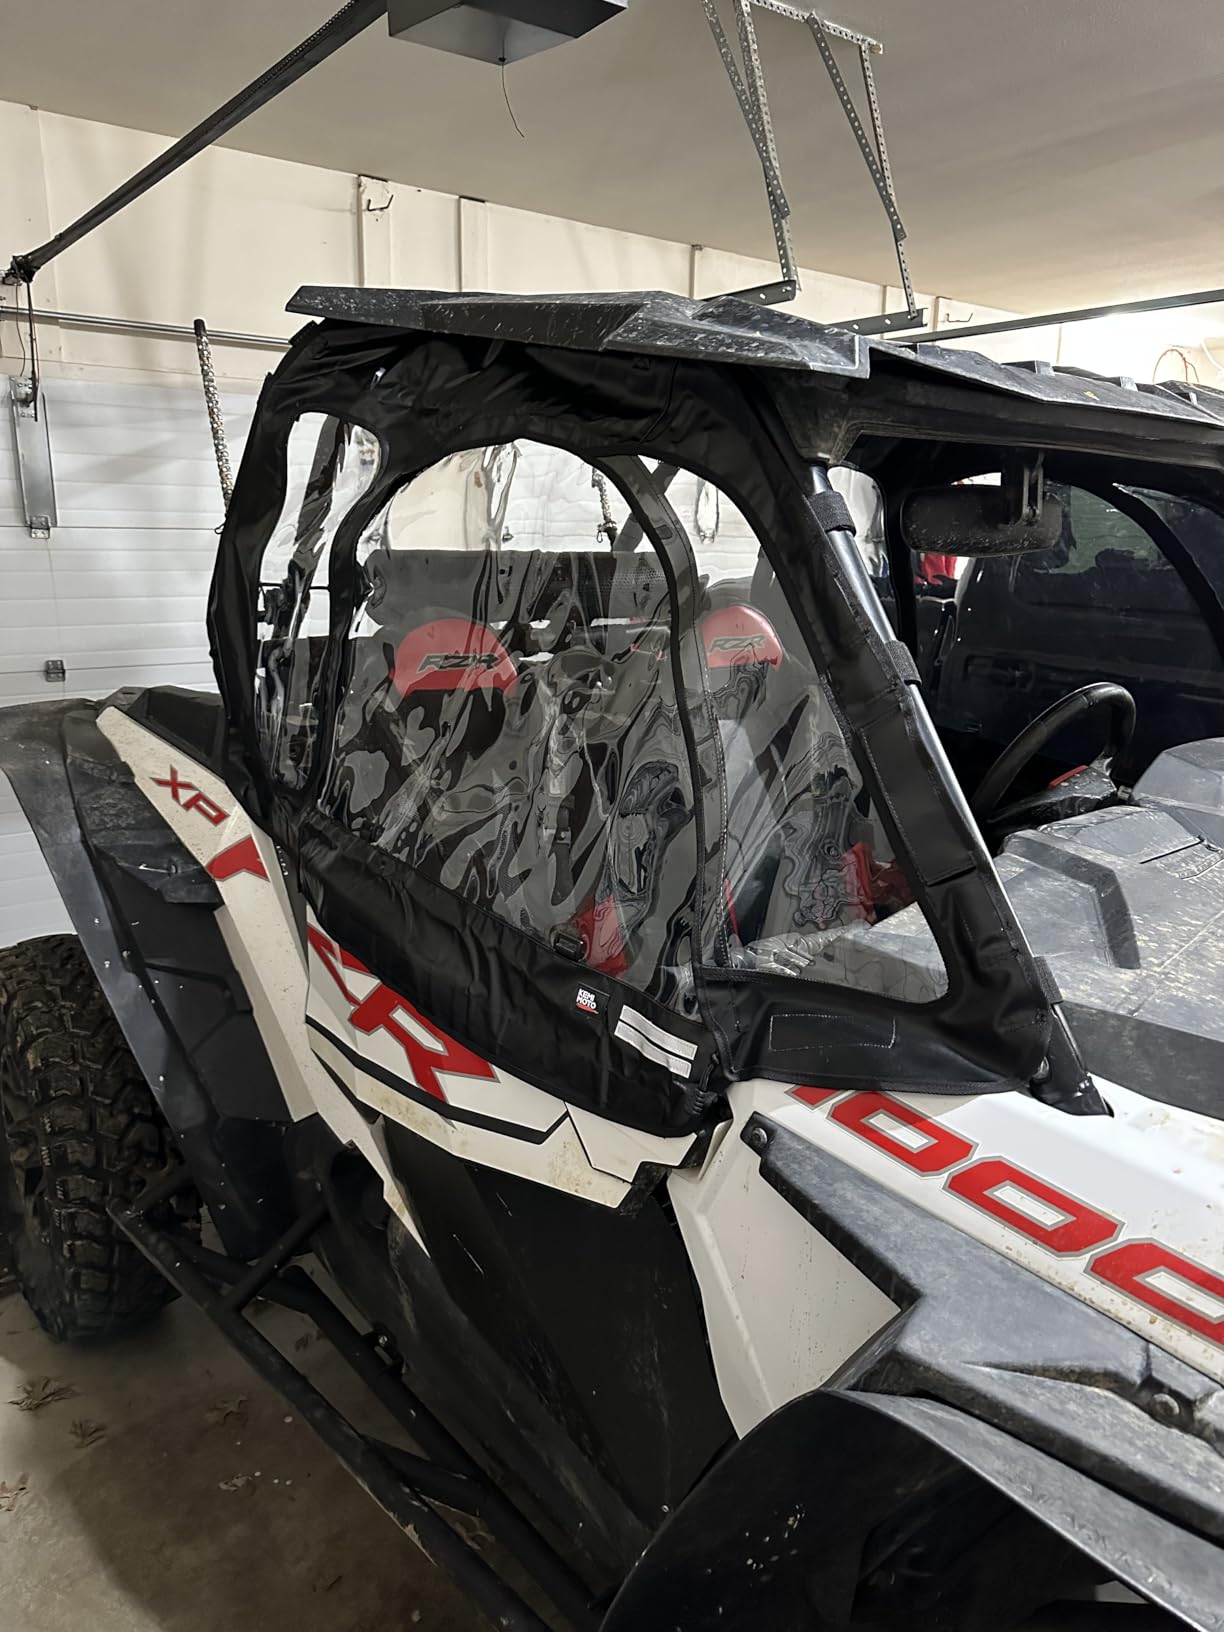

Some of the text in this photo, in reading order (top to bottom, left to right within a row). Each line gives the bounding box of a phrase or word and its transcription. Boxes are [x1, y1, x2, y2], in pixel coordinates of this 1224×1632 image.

[708, 633, 766, 655] RZR
[416, 652, 500, 674] RZR
[149, 764, 231, 827] XP
[576, 994, 597, 1010] MOTO
[577, 988, 595, 1002] KEMI
